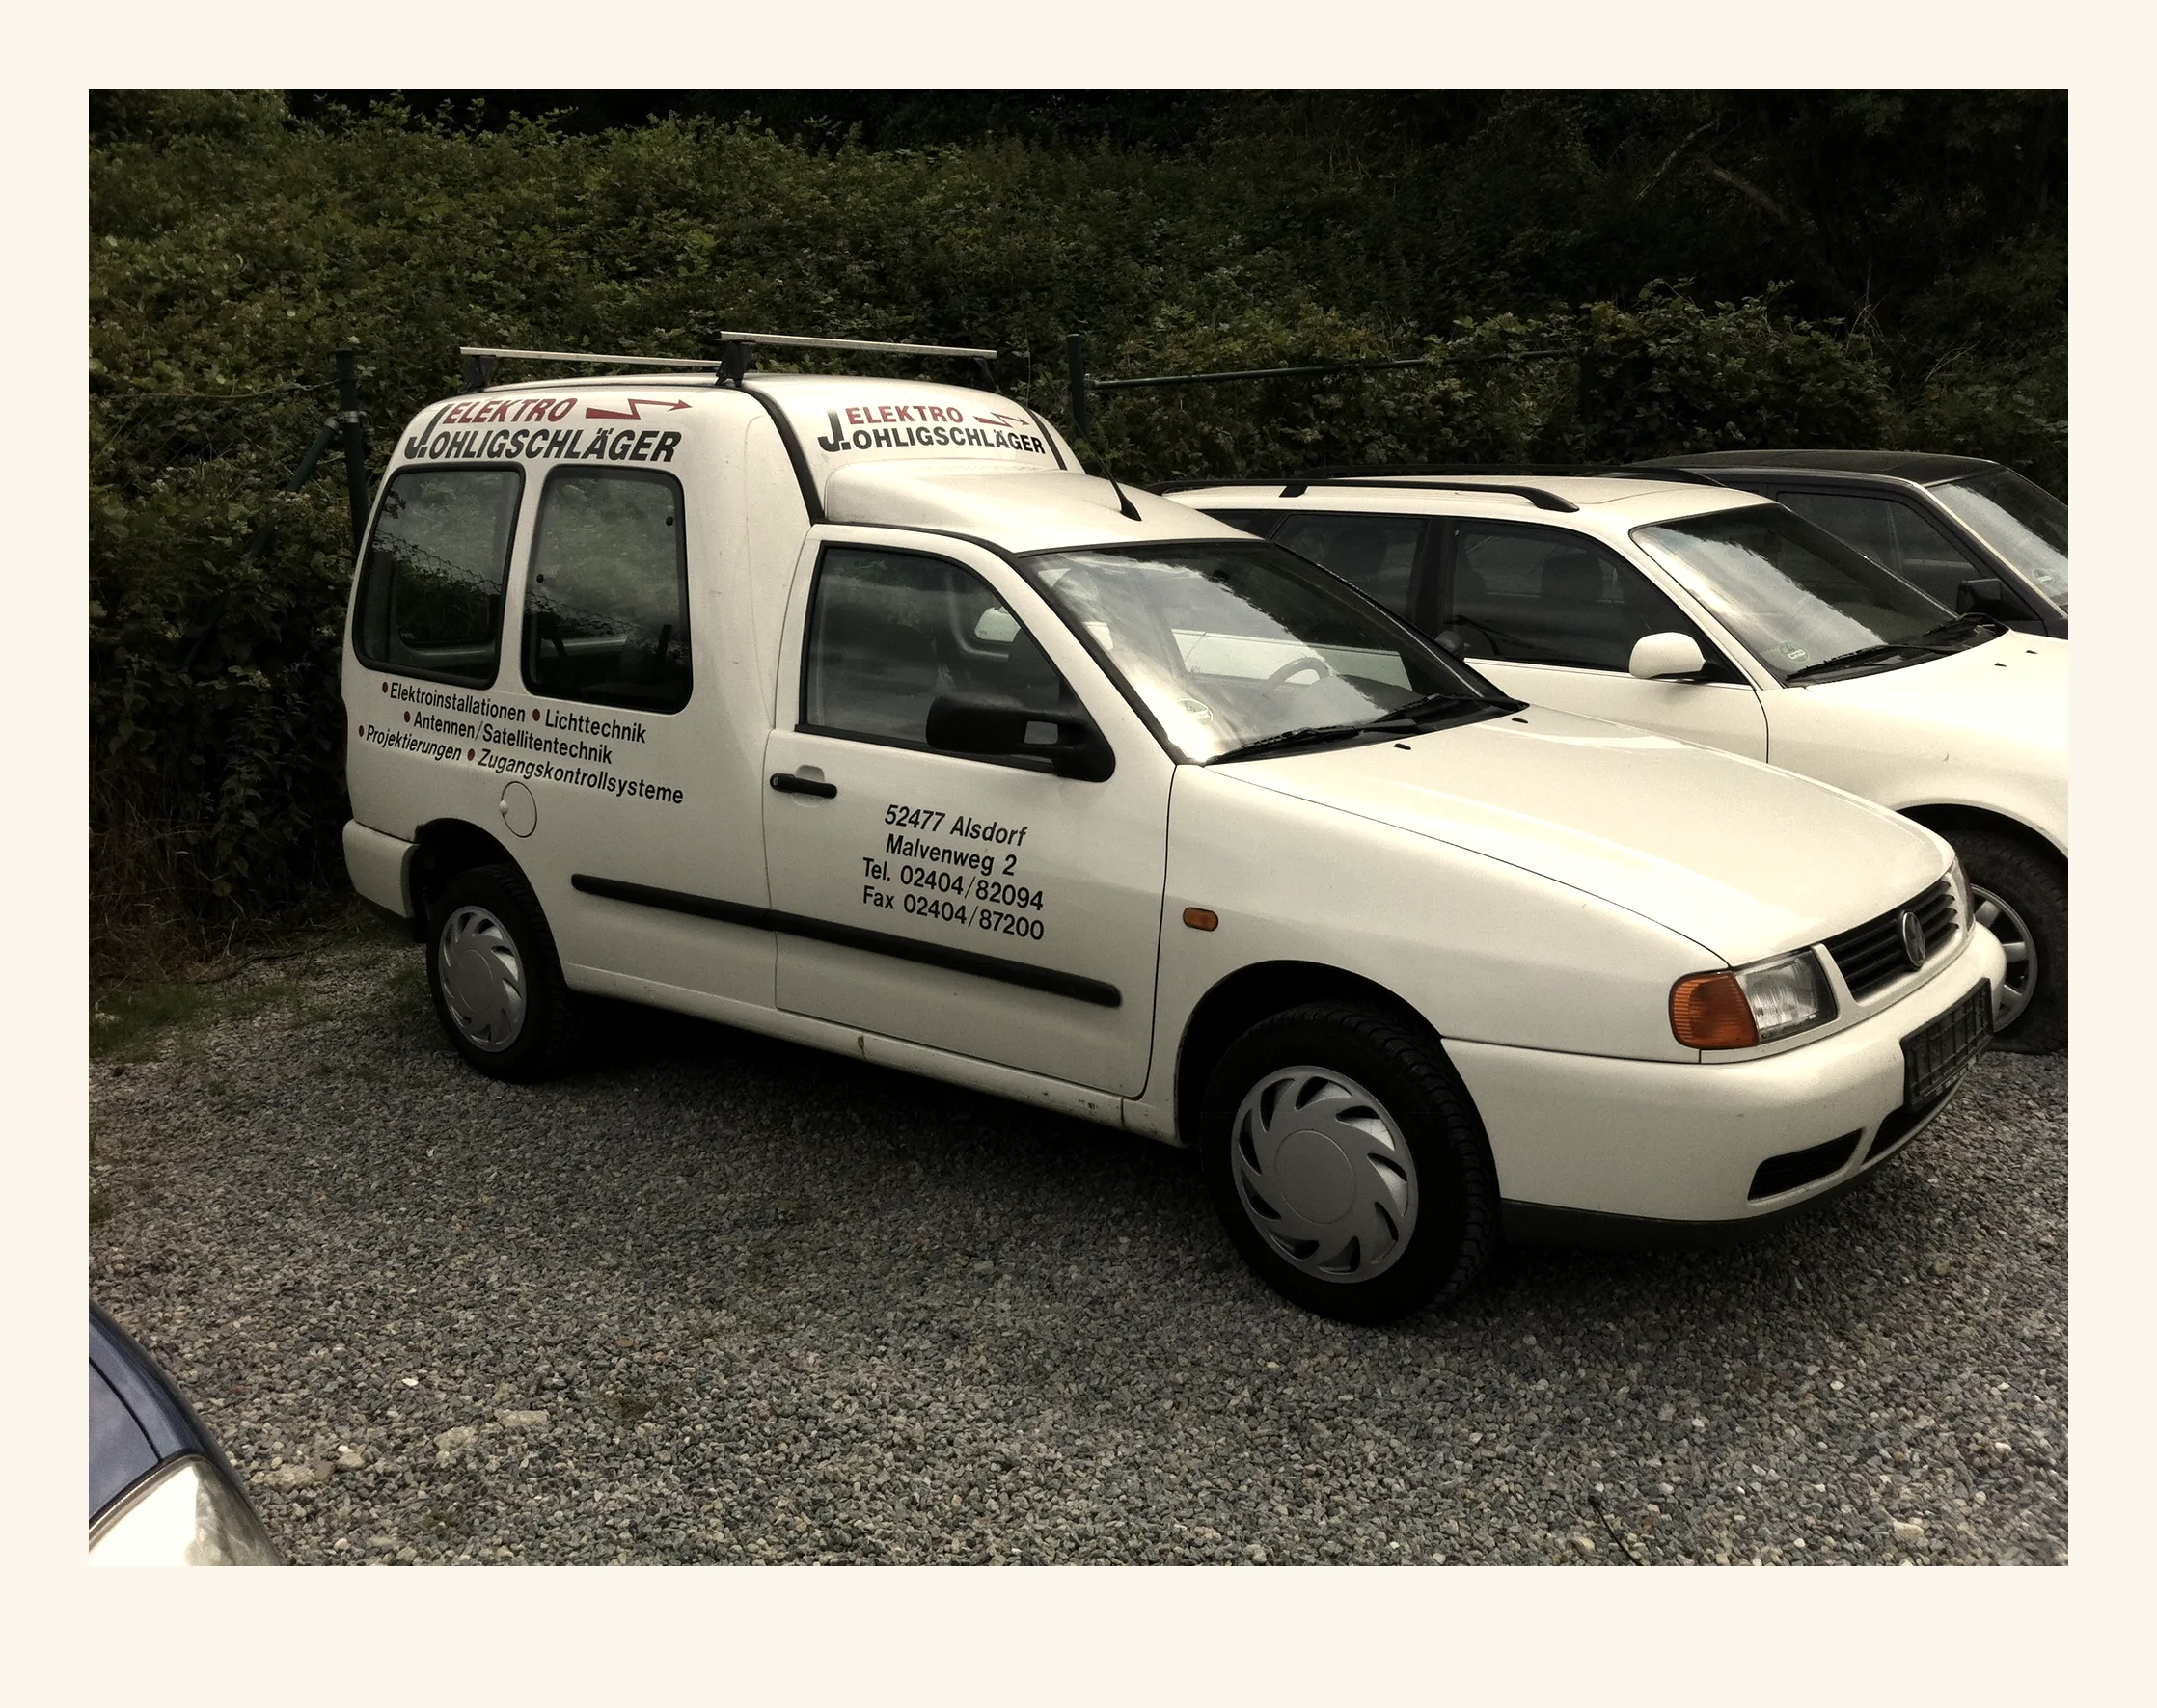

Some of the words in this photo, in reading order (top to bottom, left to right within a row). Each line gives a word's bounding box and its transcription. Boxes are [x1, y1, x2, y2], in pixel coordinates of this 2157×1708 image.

[442, 397, 578, 424] ELEKTRO
[845, 405, 964, 425] ELEKTRO
[390, 682, 526, 722] Elektroinstallationen
[545, 709, 646, 744] Lichttechnik
[413, 711, 613, 765] Antennen/Satellitentechnik
[366, 725, 462, 762] Projektierungen
[478, 748, 684, 804] Zugangskontrollsysteme
[884, 804, 946, 832] 52477
[949, 816, 1028, 846] Alsdorf
[886, 833, 995, 876] Malvenweg
[1002, 854, 1017, 876] 2
[862, 857, 891, 881] Tel.
[900, 864, 1044, 911] 02404/82094
[862, 884, 894, 909] Fax
[904, 893, 1045, 940] 02404/87200
